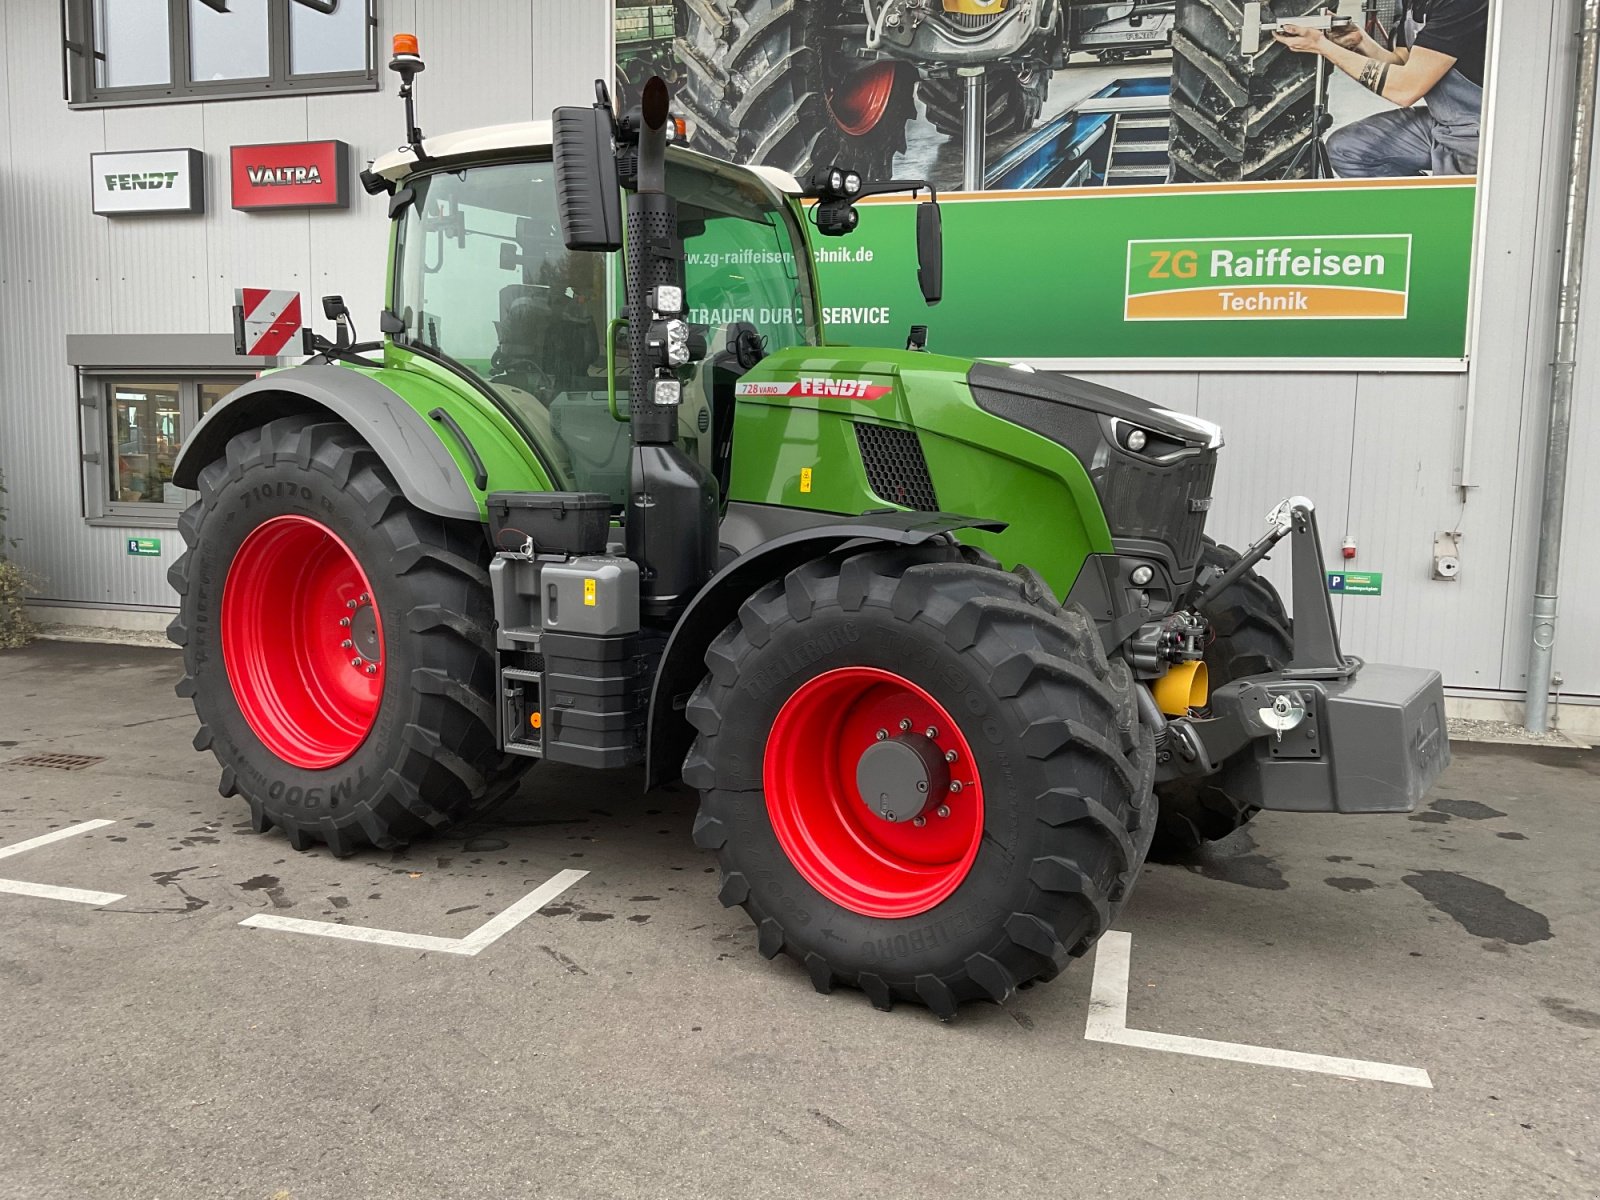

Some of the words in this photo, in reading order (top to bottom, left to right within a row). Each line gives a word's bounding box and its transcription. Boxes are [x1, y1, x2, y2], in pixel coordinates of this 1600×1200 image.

[104, 171, 178, 191] FENDT
[247, 165, 322, 187] VALTRA
[1148, 250, 1198, 278] ZG
[1210, 248, 1385, 277] Raiffeisen
[1218, 291, 1308, 311] Technik
[687, 308, 754, 325] TRAUEN
[760, 308, 803, 325] DURC
[822, 307, 890, 324] SERVICE
[742, 384, 758, 394] 728
[759, 386, 778, 394] VARIO
[800, 377, 872, 397] FENDT
[1332, 576, 1341, 587] P
